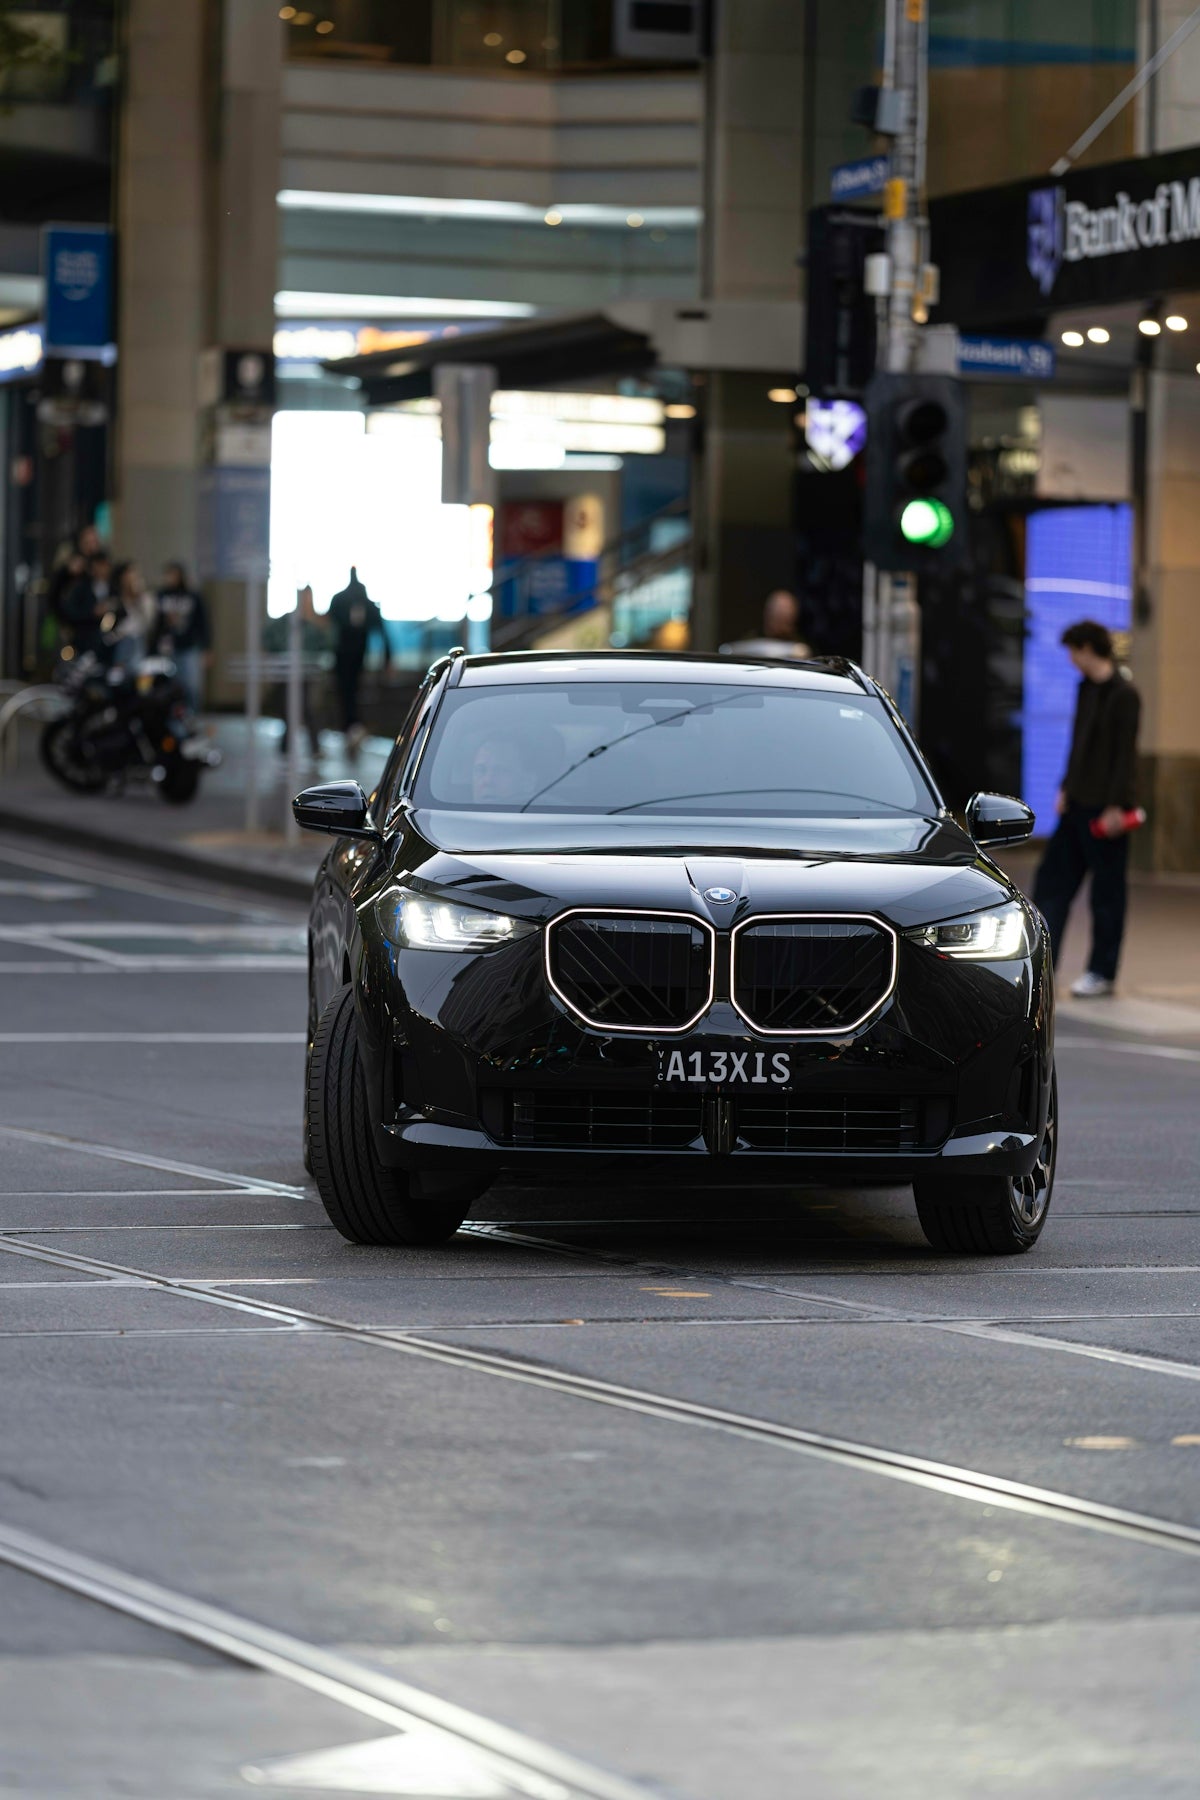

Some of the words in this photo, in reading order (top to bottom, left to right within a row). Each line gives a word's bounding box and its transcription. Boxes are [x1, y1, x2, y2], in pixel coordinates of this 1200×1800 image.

[1063, 191, 1139, 262] Bank
[1136, 182, 1169, 248] of
[1167, 176, 1200, 243] M
[665, 1050, 791, 1084] A13XIS
